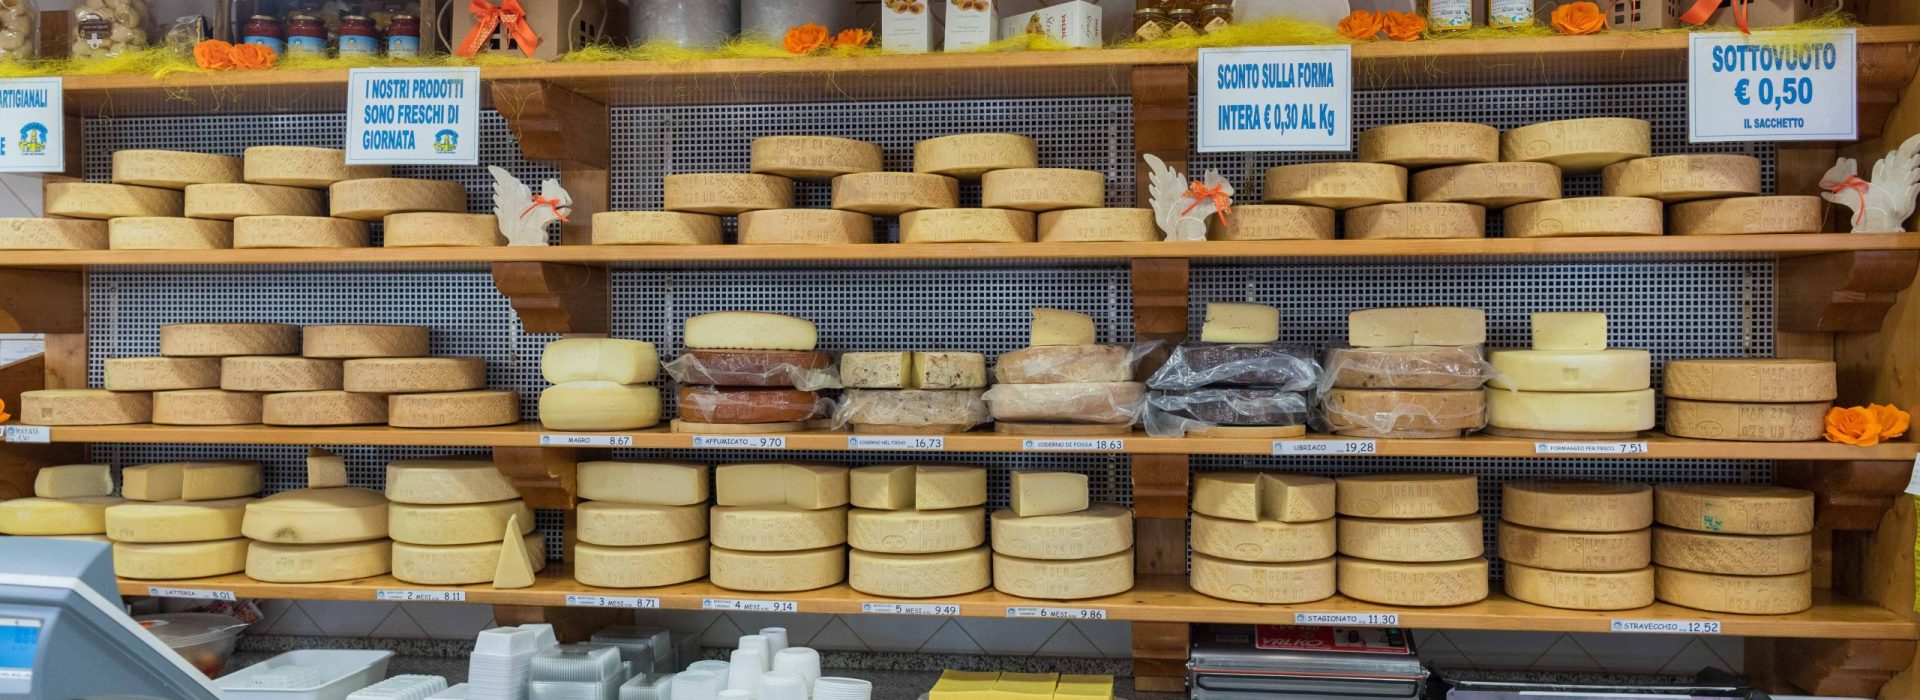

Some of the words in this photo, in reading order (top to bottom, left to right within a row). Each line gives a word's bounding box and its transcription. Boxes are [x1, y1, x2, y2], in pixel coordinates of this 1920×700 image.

[1712, 43, 1836, 72] SOTTOVUOTO
[1218, 64, 1260, 89] SCONTO
[1262, 63, 1295, 88] SULLA
[1298, 62, 1334, 88] FORMA
[366, 80, 370, 98] I
[372, 79, 410, 98] NOSTRI
[412, 78, 464, 98] PRODOTTI
[1735, 78, 1750, 105] €
[1758, 77, 1813, 110] 0,50
[364, 104, 394, 124] SONO
[398, 104, 444, 124] FRESCHI
[448, 104, 459, 124] DI
[1218, 104, 1260, 130] INTERA
[1264, 104, 1271, 130] €
[1274, 104, 1298, 136] 0,30
[1301, 104, 1316, 129] AL
[1320, 104, 1335, 136] Kg
[1744, 119, 1752, 128] IL
[1754, 118, 1804, 128] SACCHETTO
[362, 130, 416, 150] GIORNATA
[1741, 407, 1765, 419] MAR
[1770, 407, 1785, 419] 27
[915, 438, 942, 449] 16,73
[1345, 442, 1374, 454] 19,28
[1386, 572, 1407, 584] GEN
[1412, 572, 1425, 585] 17
[408, 592, 412, 600] 2
[600, 598, 604, 606] 3
[735, 601, 740, 609] 4
[896, 604, 902, 613] 5
[1040, 608, 1046, 616] 6
[1624, 622, 1678, 630] STRAVECCHIO
